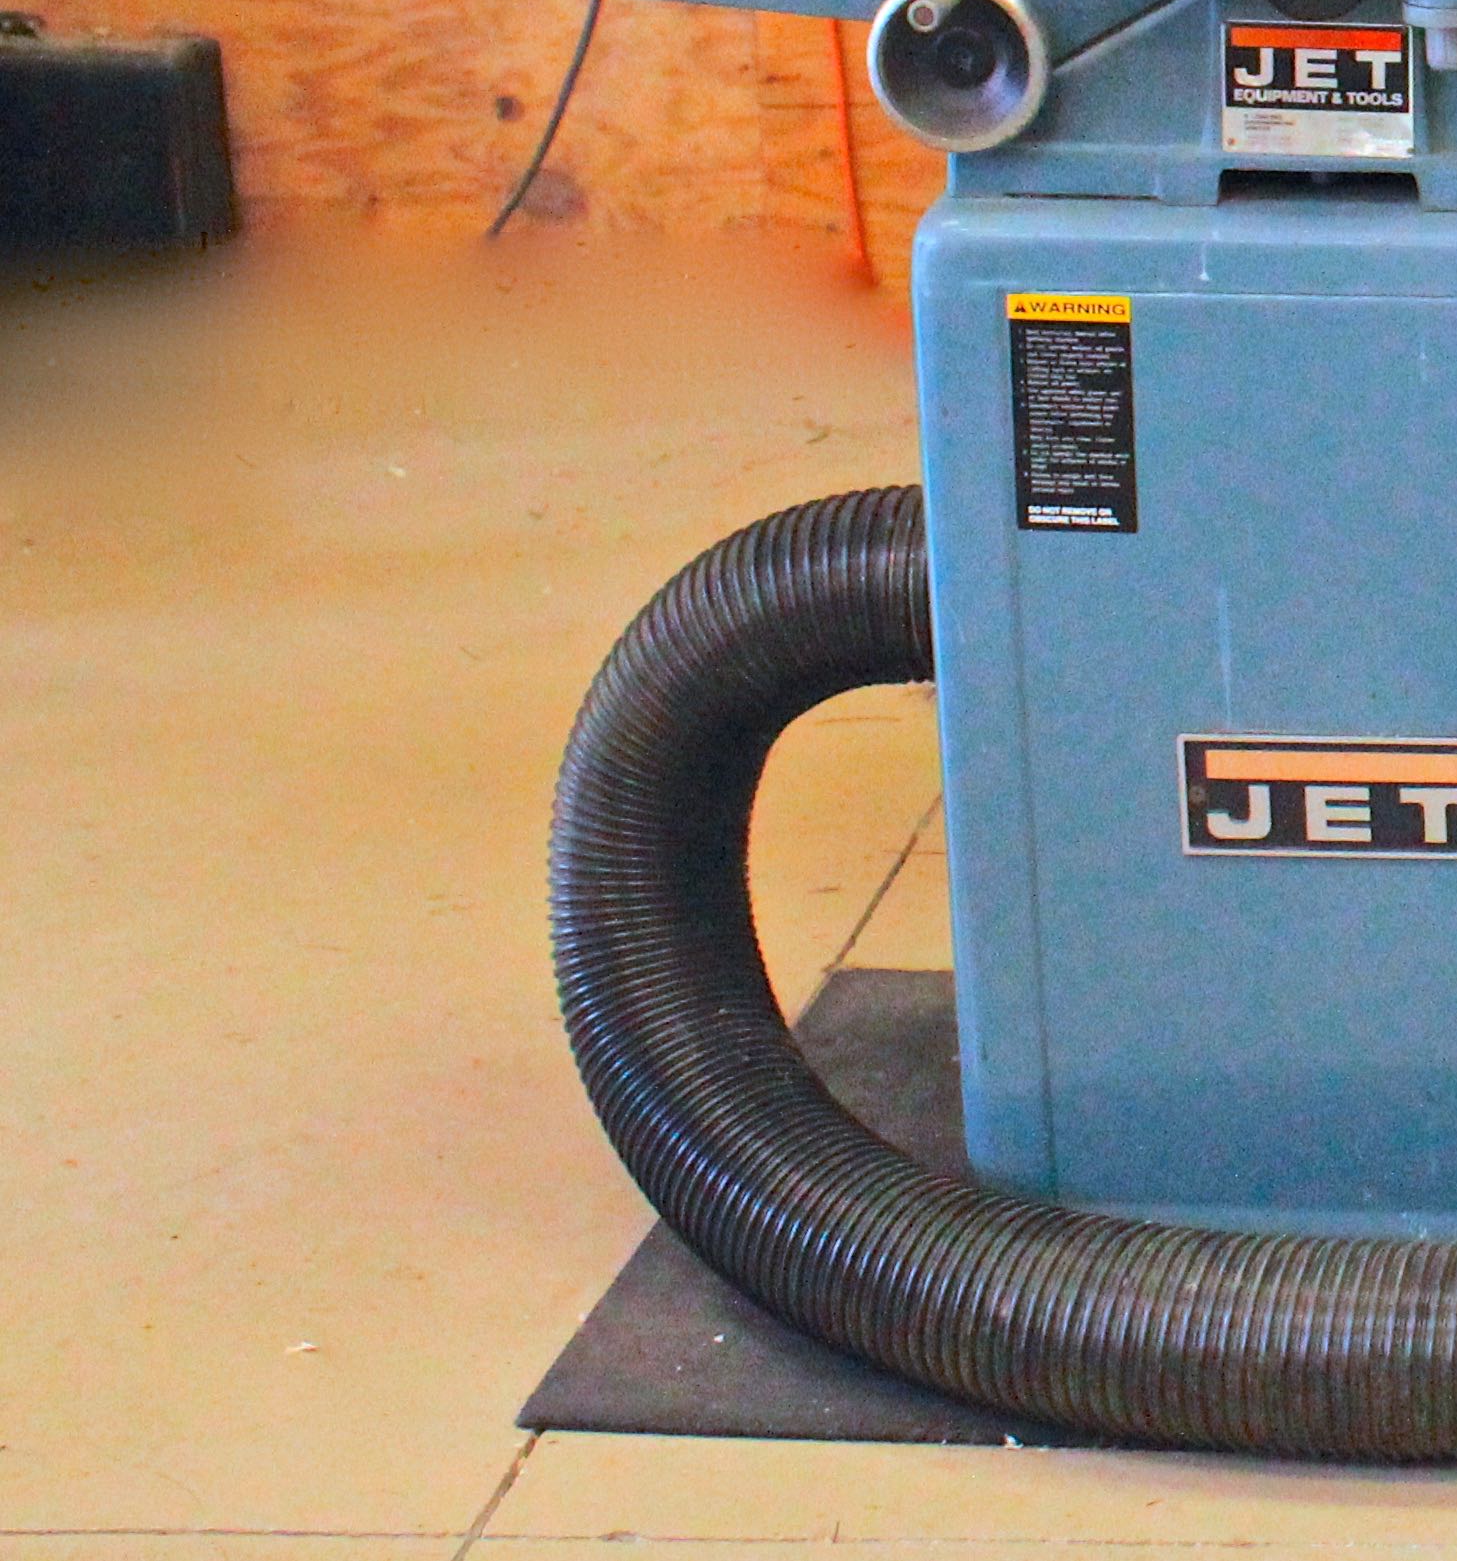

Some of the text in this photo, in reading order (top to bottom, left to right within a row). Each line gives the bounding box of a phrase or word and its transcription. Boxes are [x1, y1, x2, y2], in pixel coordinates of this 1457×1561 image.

[1233, 47, 1402, 89] JET
[1233, 88, 1403, 106] EQUIPMENT & TOOLS
[1030, 301, 1126, 316] WARNING
